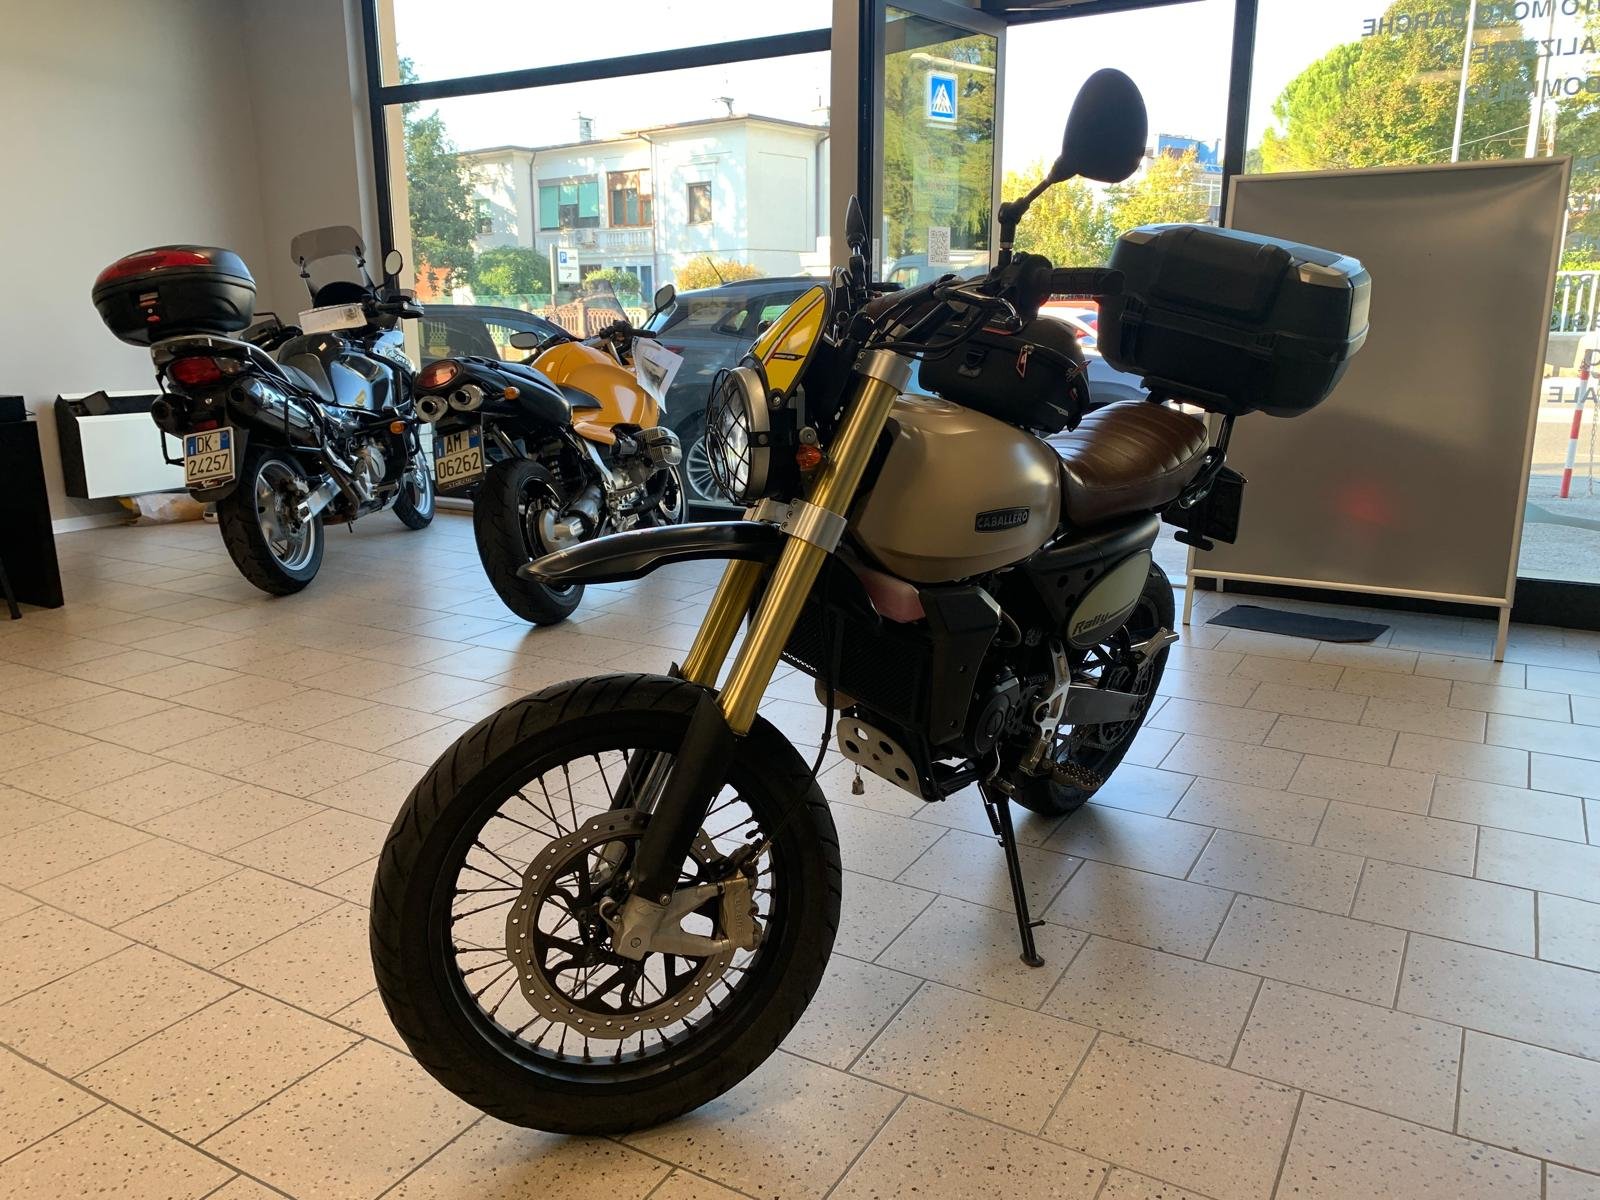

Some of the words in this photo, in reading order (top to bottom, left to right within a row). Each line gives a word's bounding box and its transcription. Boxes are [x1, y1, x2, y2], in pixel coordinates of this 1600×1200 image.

[197, 435, 212, 453] DK
[446, 433, 462, 454] AM
[189, 453, 229, 476] 24257
[438, 451, 480, 479] 06262
[976, 511, 1028, 529] CABALLERO
[1072, 612, 1110, 635] Rally
